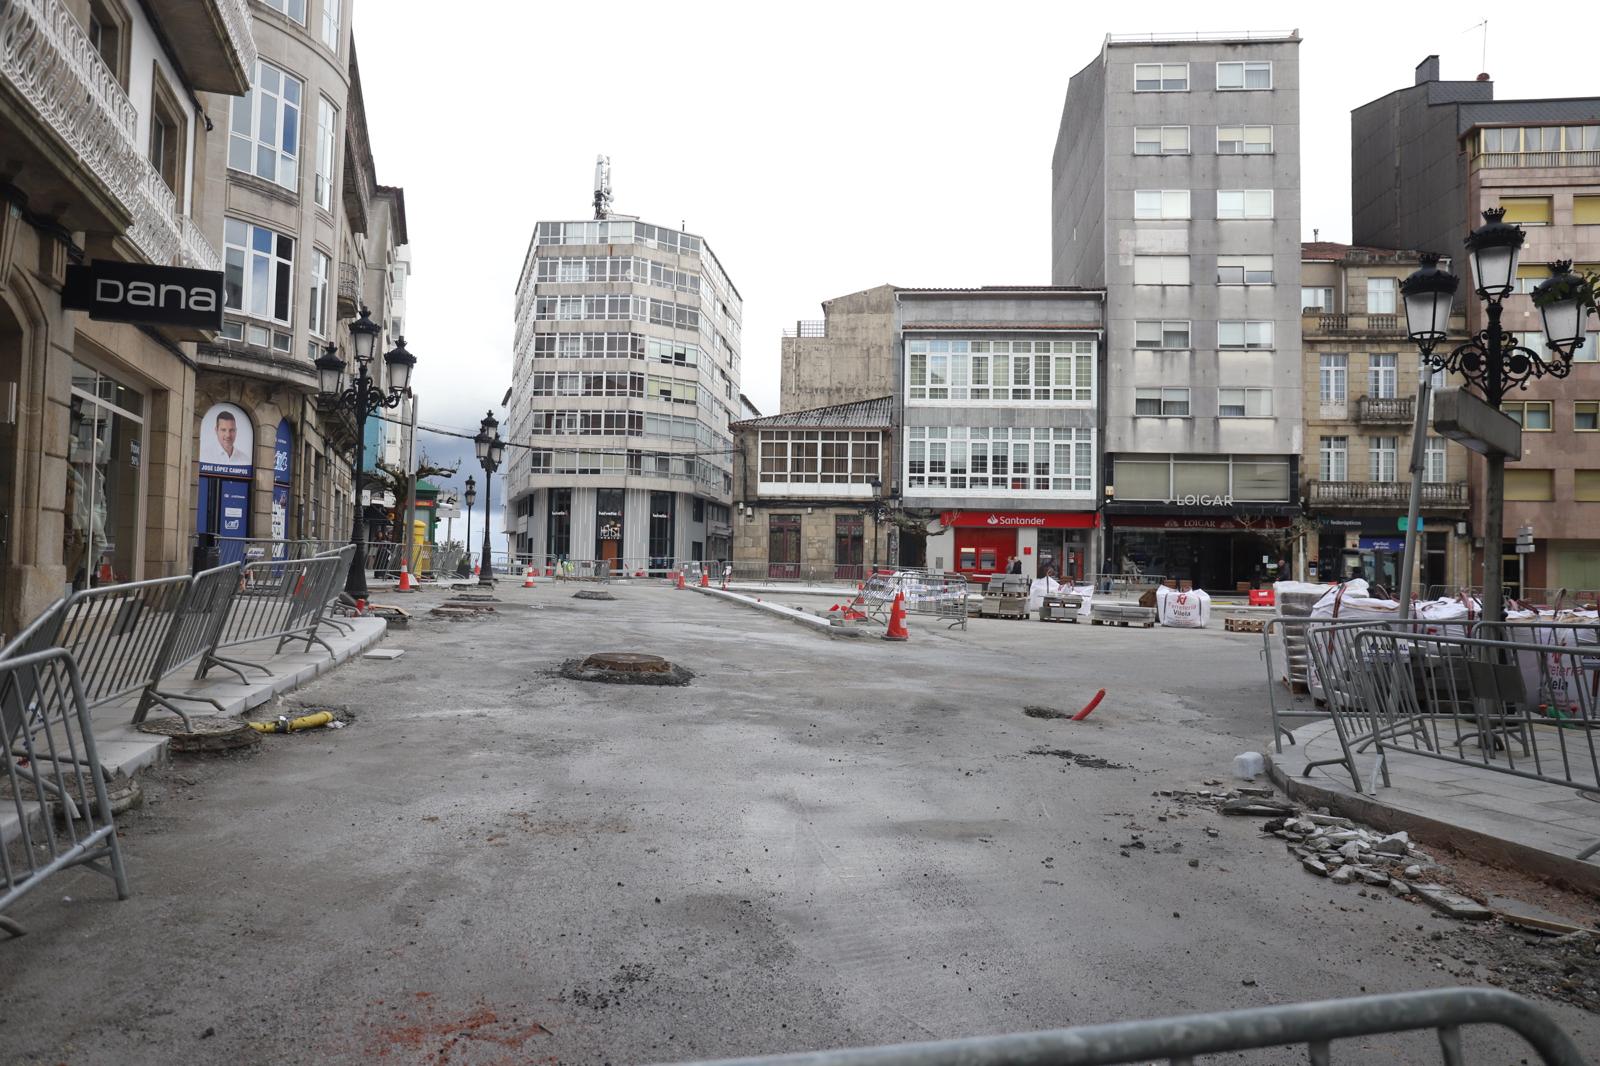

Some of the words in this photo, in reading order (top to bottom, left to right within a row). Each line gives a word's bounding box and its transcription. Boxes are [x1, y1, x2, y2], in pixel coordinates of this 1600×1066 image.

[229, 467, 248, 475] CAMPOS
[1176, 494, 1234, 507] LOIGAR
[999, 516, 1046, 525] Santander
[1184, 519, 1216, 528] LOIGAR
[1173, 609, 1191, 617] Vilela
